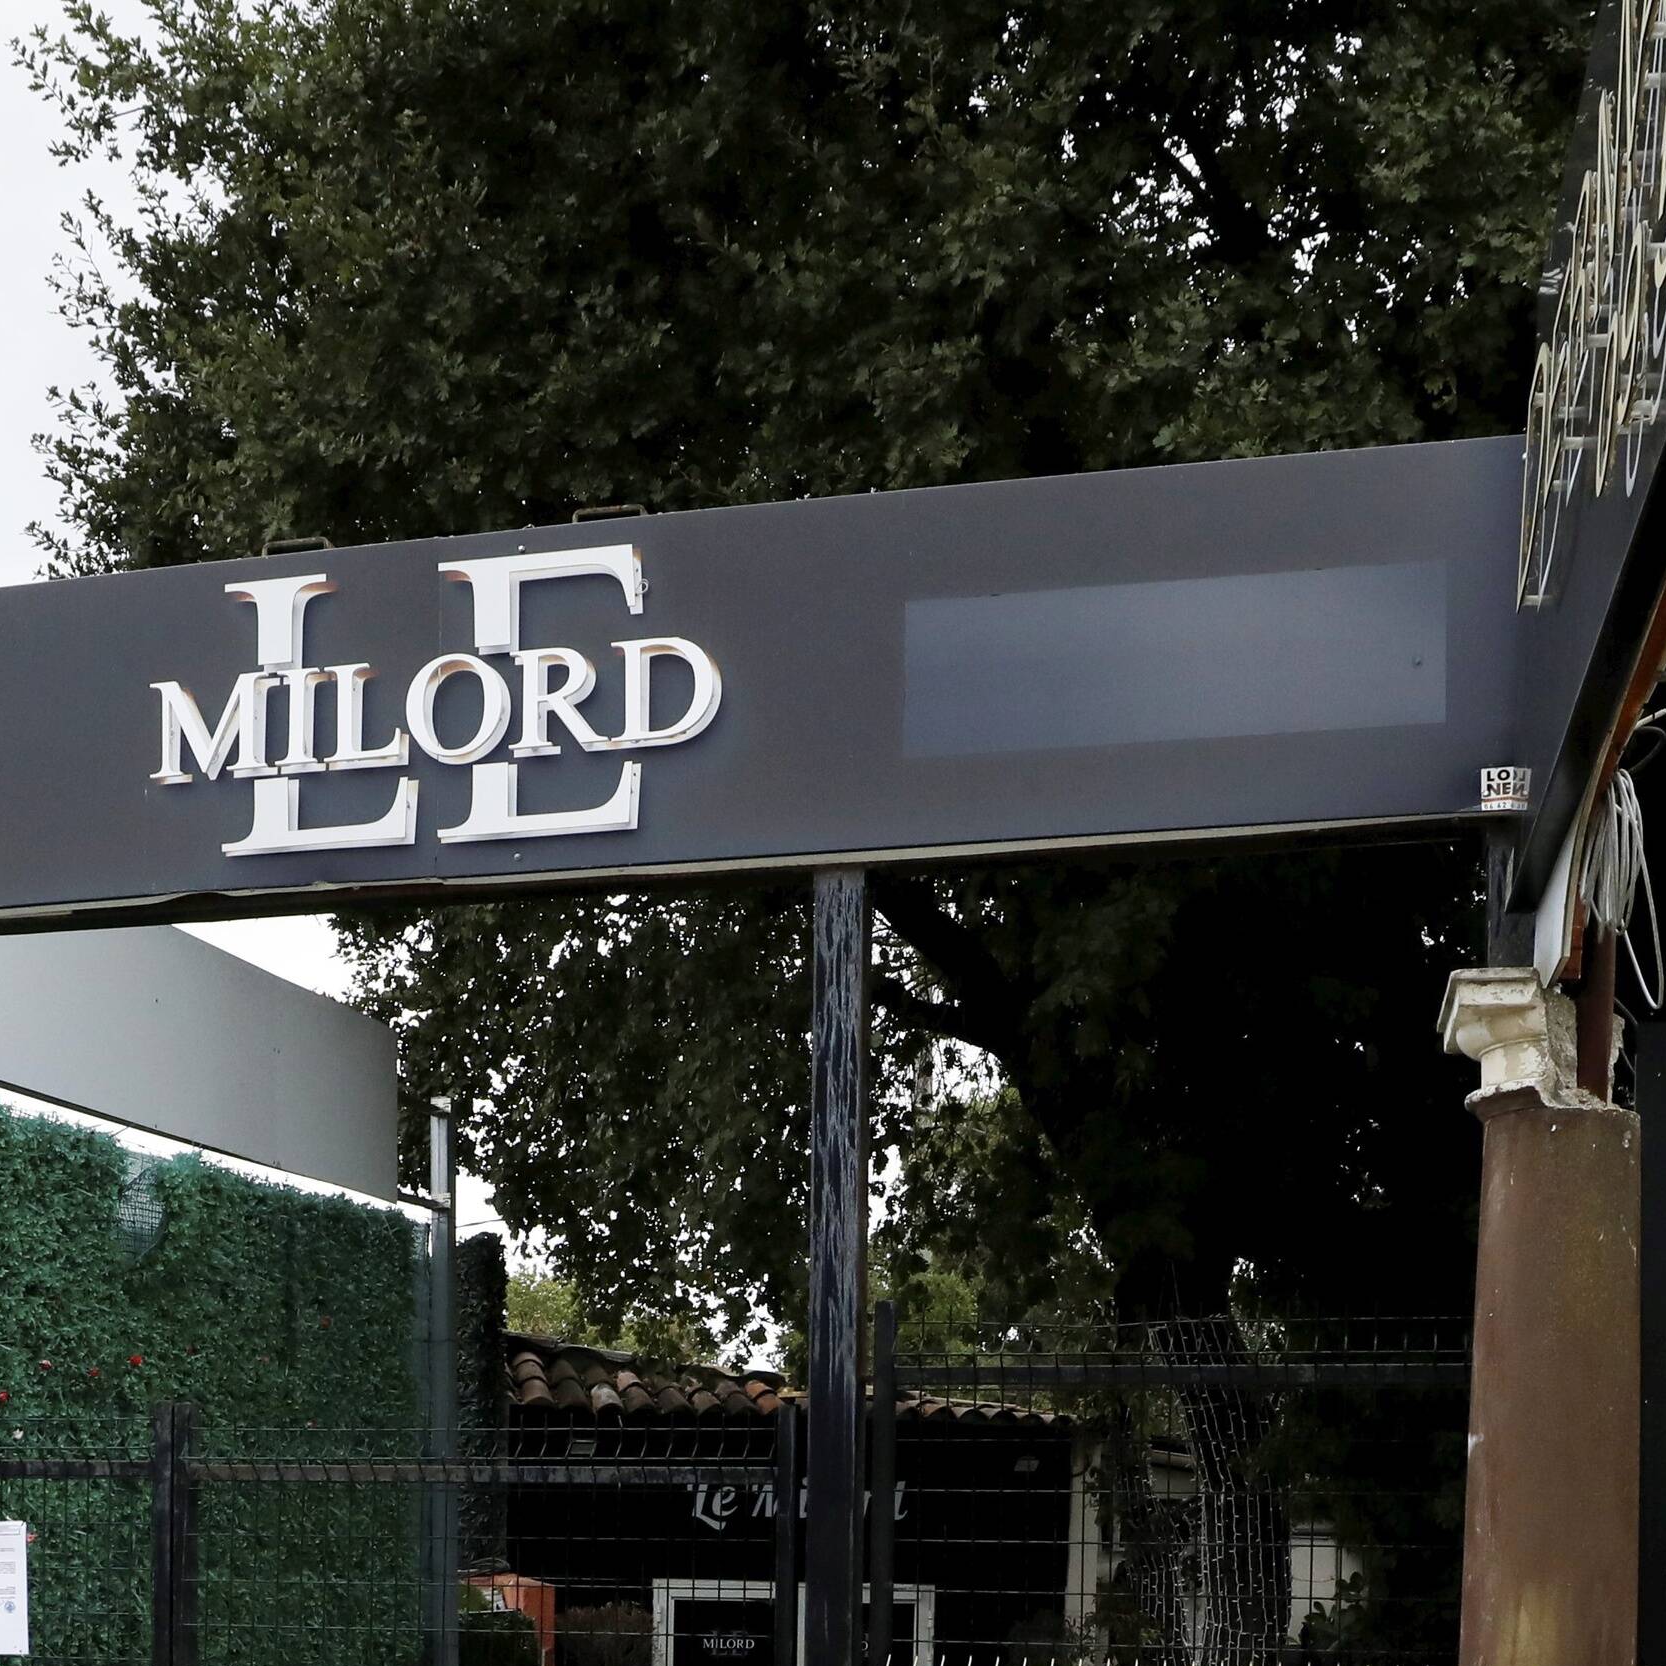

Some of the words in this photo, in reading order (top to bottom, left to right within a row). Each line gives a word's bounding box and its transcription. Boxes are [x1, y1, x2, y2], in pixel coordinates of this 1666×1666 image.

[149, 637, 723, 785] MILORD
[221, 544, 643, 857] LE
[702, 1638, 755, 1650] MILORD
